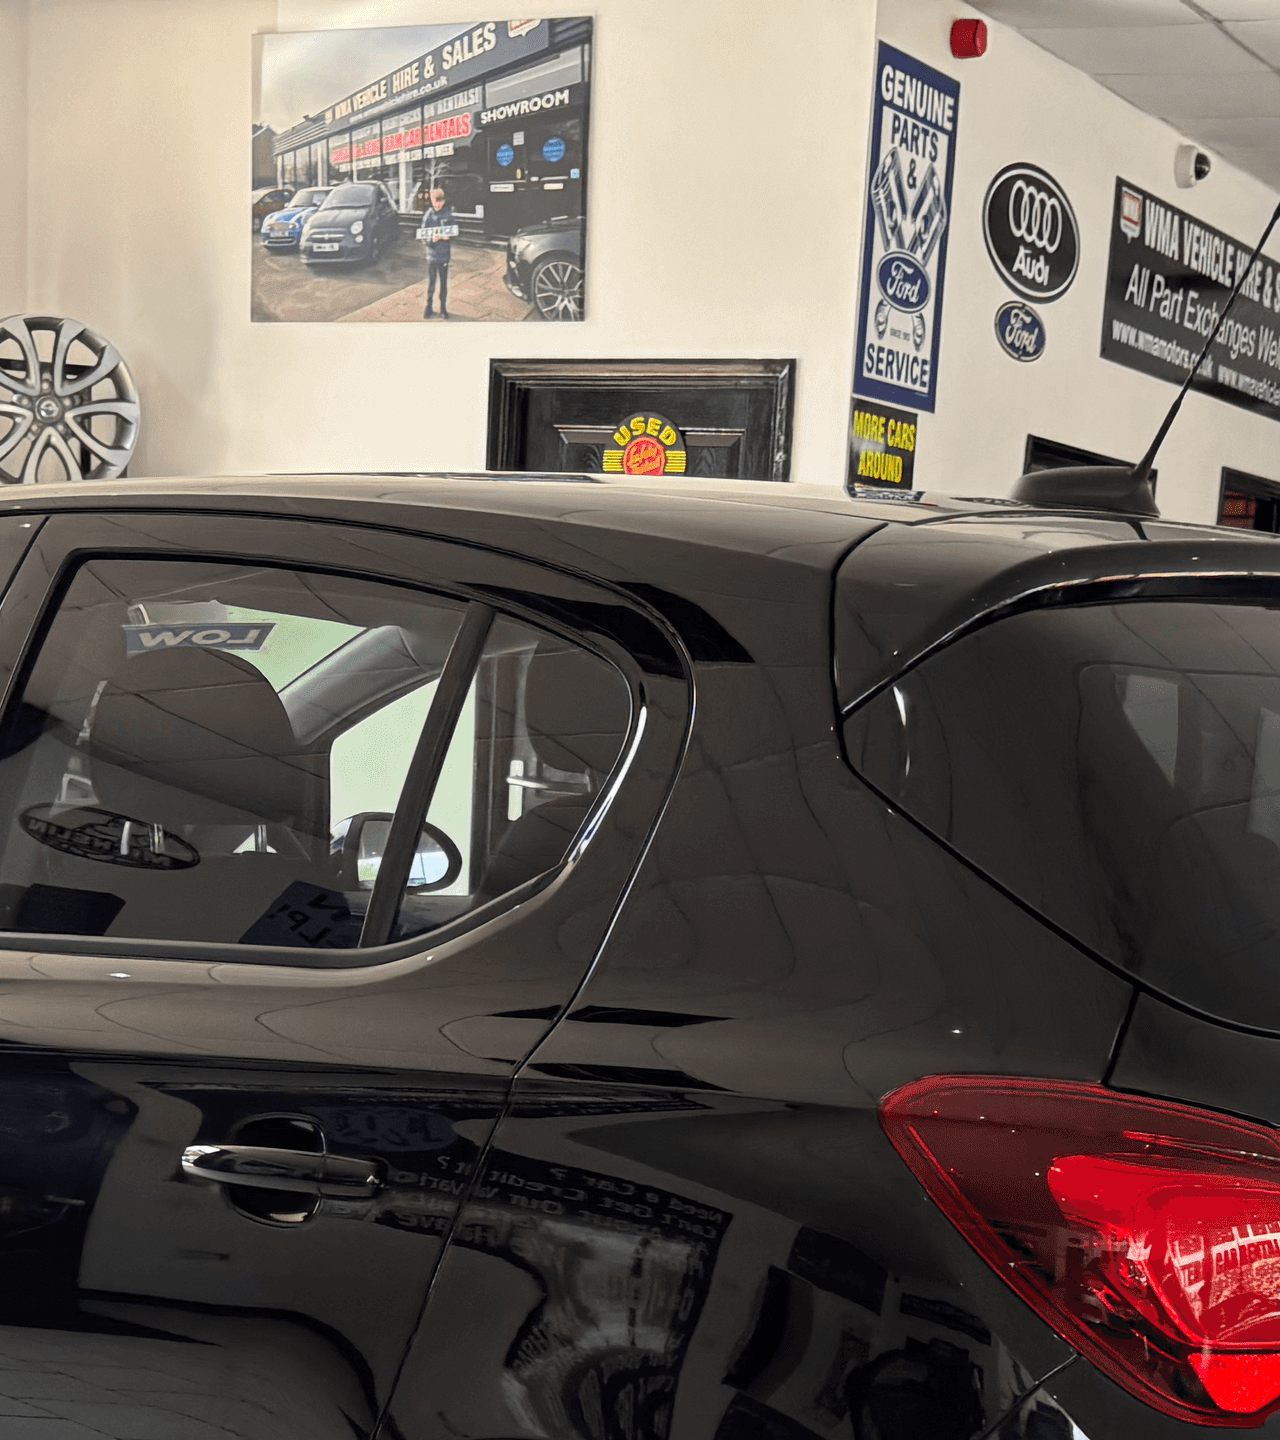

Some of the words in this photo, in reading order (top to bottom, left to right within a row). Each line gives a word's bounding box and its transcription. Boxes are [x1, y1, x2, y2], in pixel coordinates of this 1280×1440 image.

[392, 61, 420, 94] HIRE
[423, 55, 435, 79] &
[442, 22, 497, 70] SALES
[480, 89, 569, 124] SHOWROOM
[881, 64, 954, 131] GENUINE
[892, 113, 938, 163] PARTS
[907, 158, 917, 189] &
[1012, 245, 1050, 286] Audi
[1145, 199, 1180, 261] WMA
[1183, 220, 1234, 288] VEHICLE
[1262, 266, 1273, 309] &
[887, 261, 921, 303] Ford
[1005, 309, 1039, 353] Ford
[1124, 263, 1150, 308] All
[1149, 274, 1184, 324] Part
[1183, 290, 1256, 360] Exchanges
[866, 343, 928, 387] SERVICE
[613, 416, 677, 447] USED
[853, 410, 886, 444] MORE
[888, 419, 917, 452] CARS
[858, 449, 903, 483] AROUND
